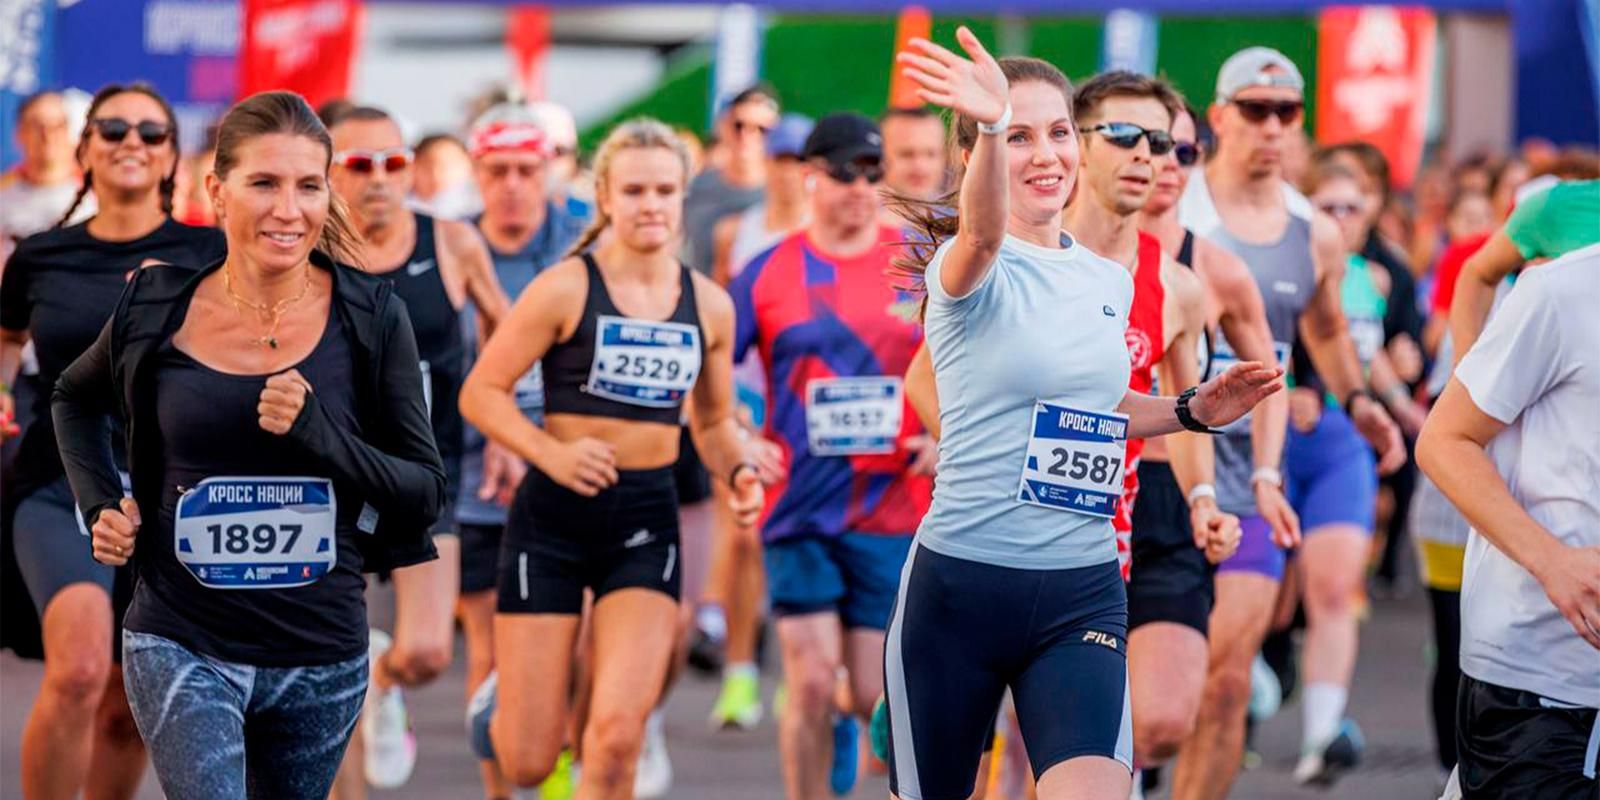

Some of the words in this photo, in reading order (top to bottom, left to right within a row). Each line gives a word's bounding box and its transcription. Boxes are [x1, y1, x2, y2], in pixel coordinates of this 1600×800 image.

[613, 353, 681, 382] 2529
[1059, 412, 1096, 432] КРОСС
[1047, 447, 1121, 486] 2587
[208, 485, 253, 503] КРОСС
[257, 485, 303, 504] НАЦИИ
[206, 523, 303, 555] 1897
[1082, 631, 1117, 648] FILA
